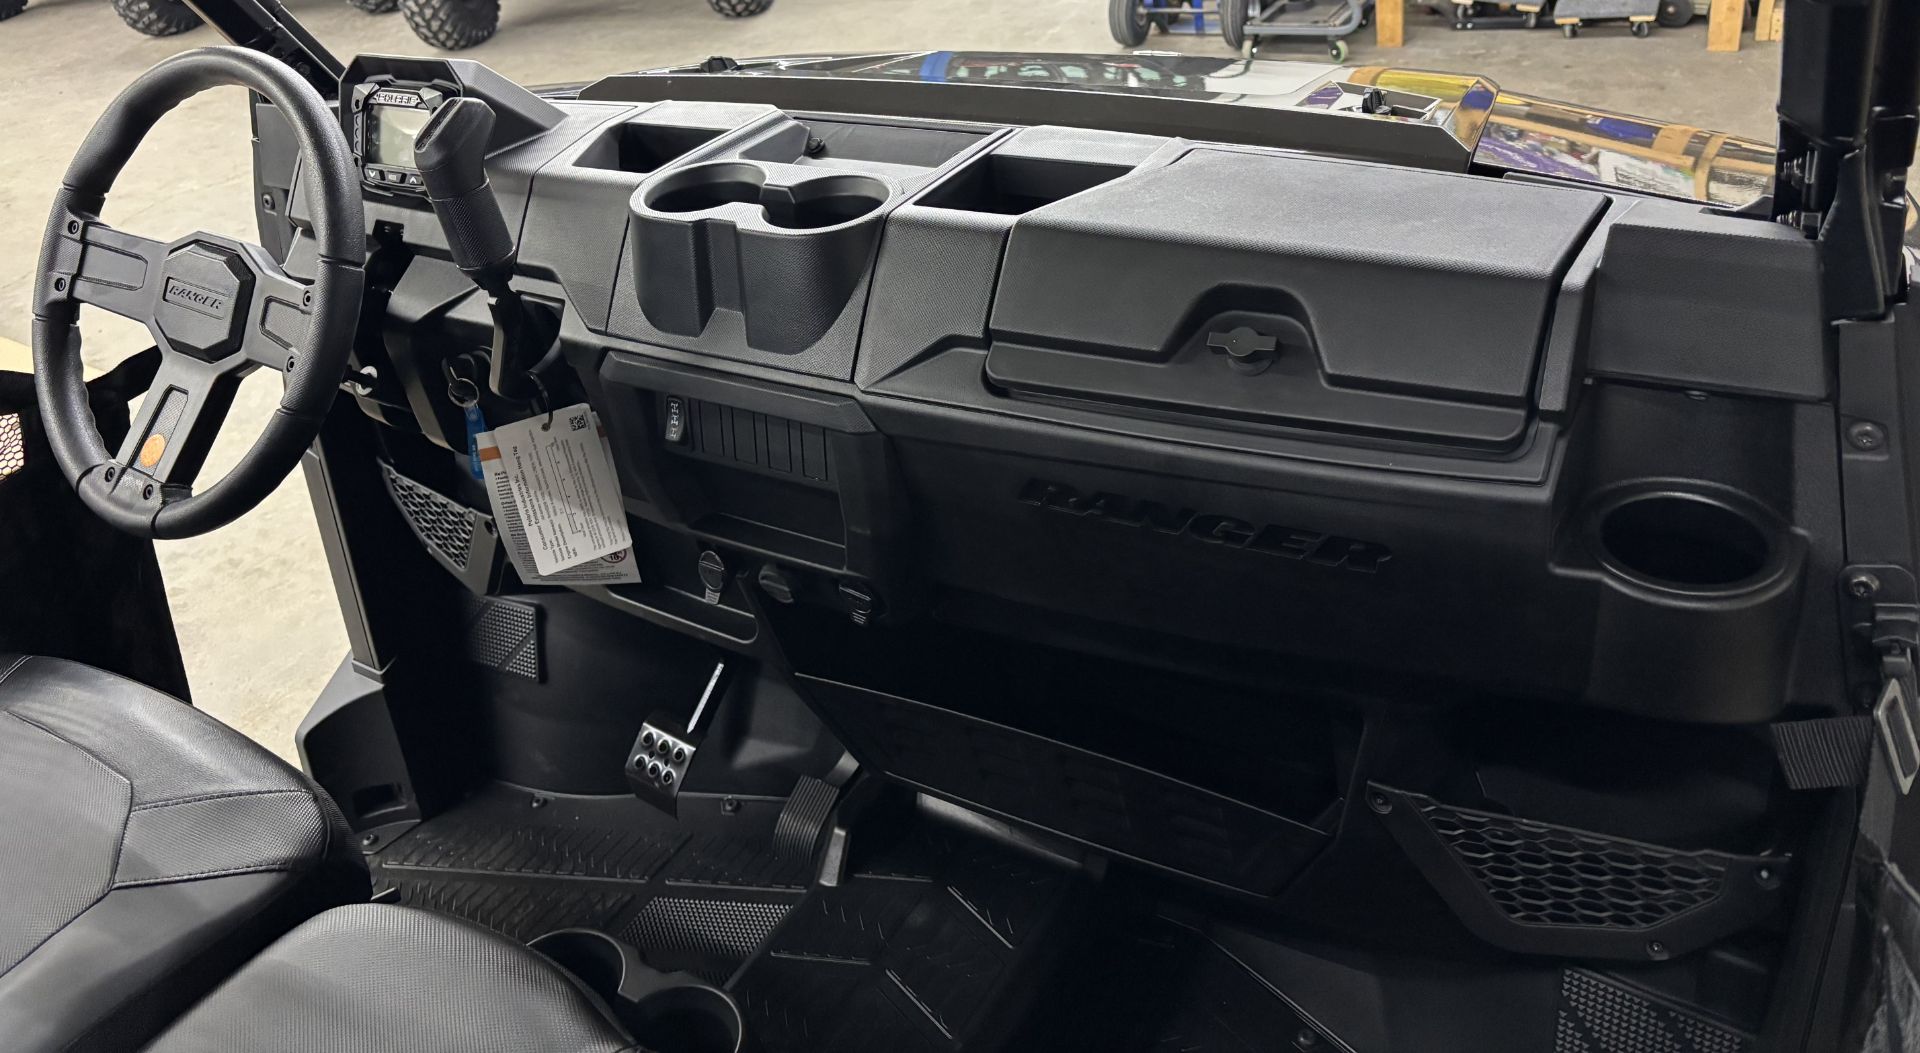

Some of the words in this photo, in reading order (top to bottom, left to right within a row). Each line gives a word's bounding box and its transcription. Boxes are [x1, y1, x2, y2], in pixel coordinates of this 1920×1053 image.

[168, 285, 222, 310] RANGER
[517, 483, 527, 509] Industries
[520, 469, 531, 499] Information
[524, 508, 533, 527] Polaris
[529, 498, 539, 525] Emissions
[537, 525, 548, 551] Consumer
[1018, 478, 1393, 574] RANGER
